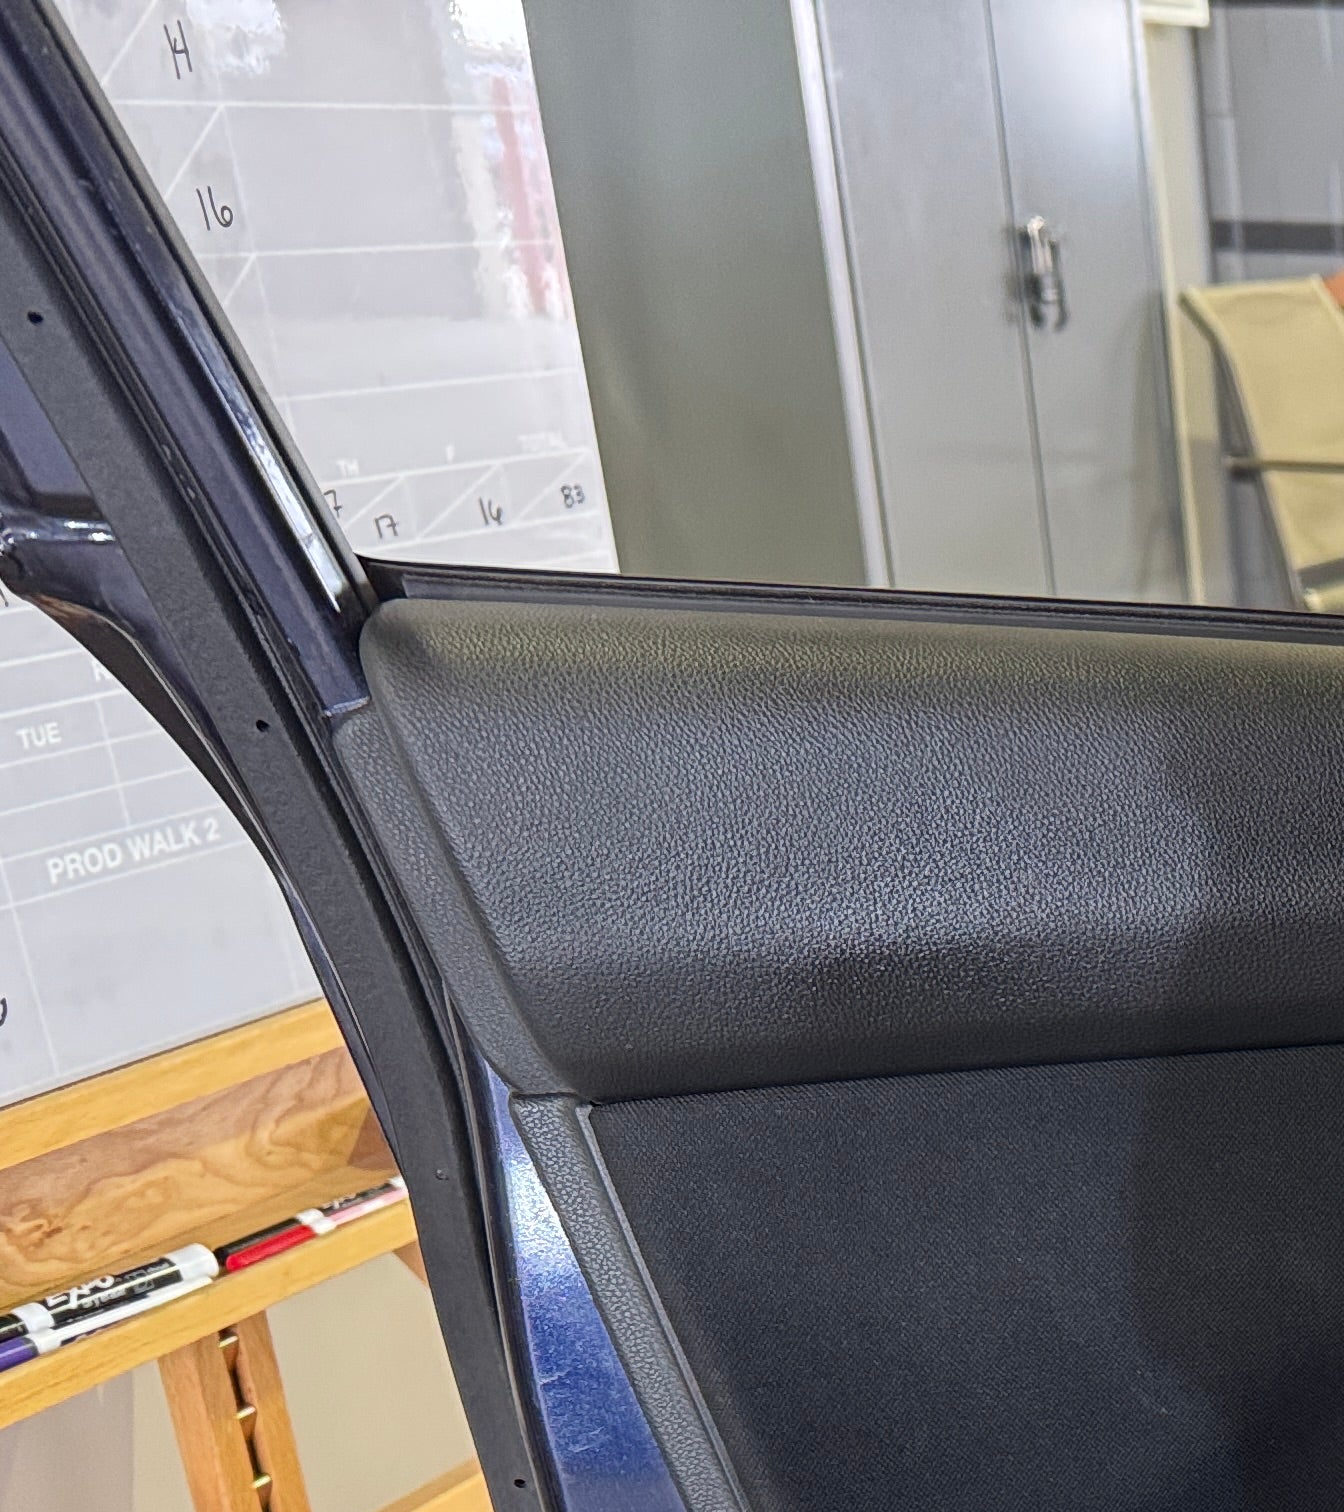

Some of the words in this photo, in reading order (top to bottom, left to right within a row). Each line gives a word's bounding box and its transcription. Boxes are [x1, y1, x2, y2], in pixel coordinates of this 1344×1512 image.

[195, 185, 234, 231] 16
[560, 484, 585, 508] 83
[16, 722, 62, 750] TUE
[46, 843, 123, 885] PROD
[126, 821, 202, 861] WALK
[204, 817, 220, 841] 2
